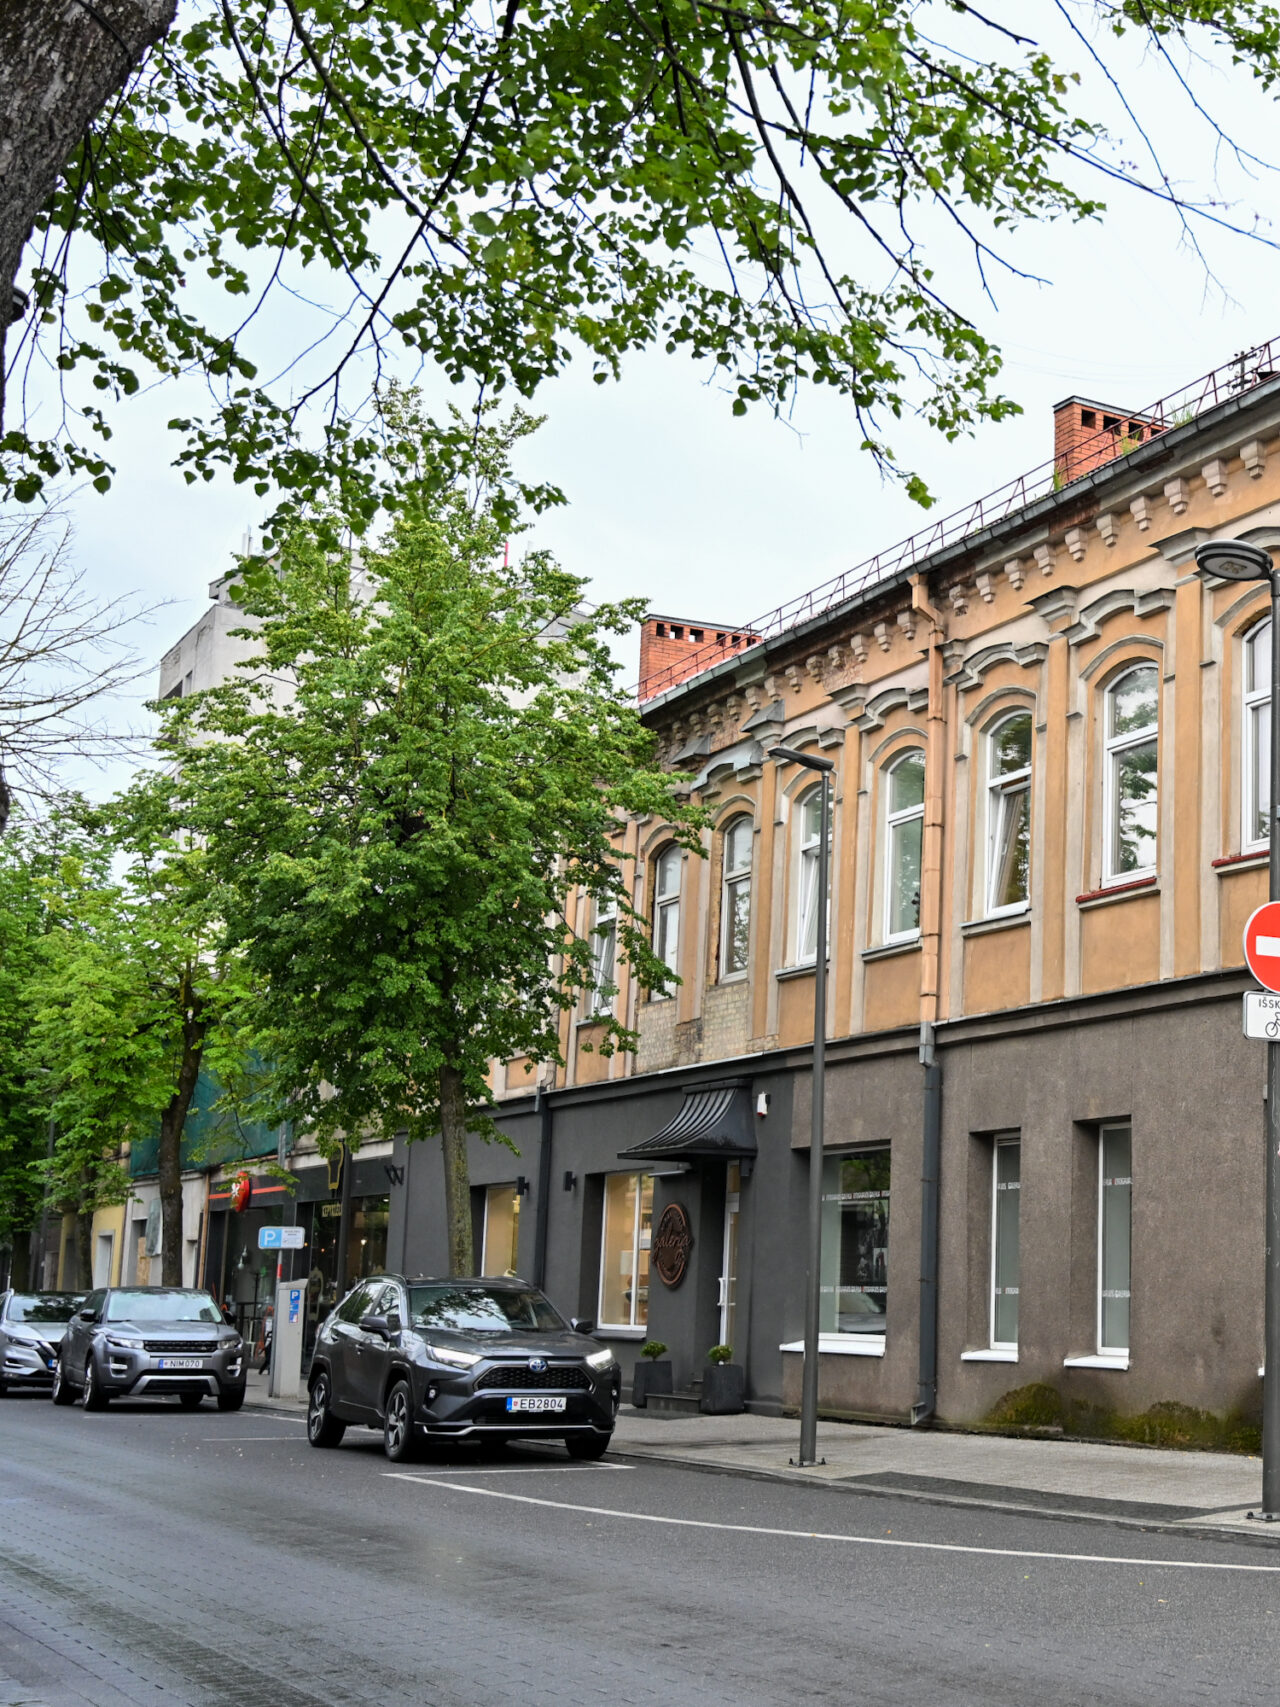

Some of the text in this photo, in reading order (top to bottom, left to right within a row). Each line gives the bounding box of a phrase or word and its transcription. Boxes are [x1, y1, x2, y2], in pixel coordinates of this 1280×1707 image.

[264, 1230, 276, 1246] P
[291, 1291, 299, 1299] P
[520, 1399, 563, 1409] EB2804
